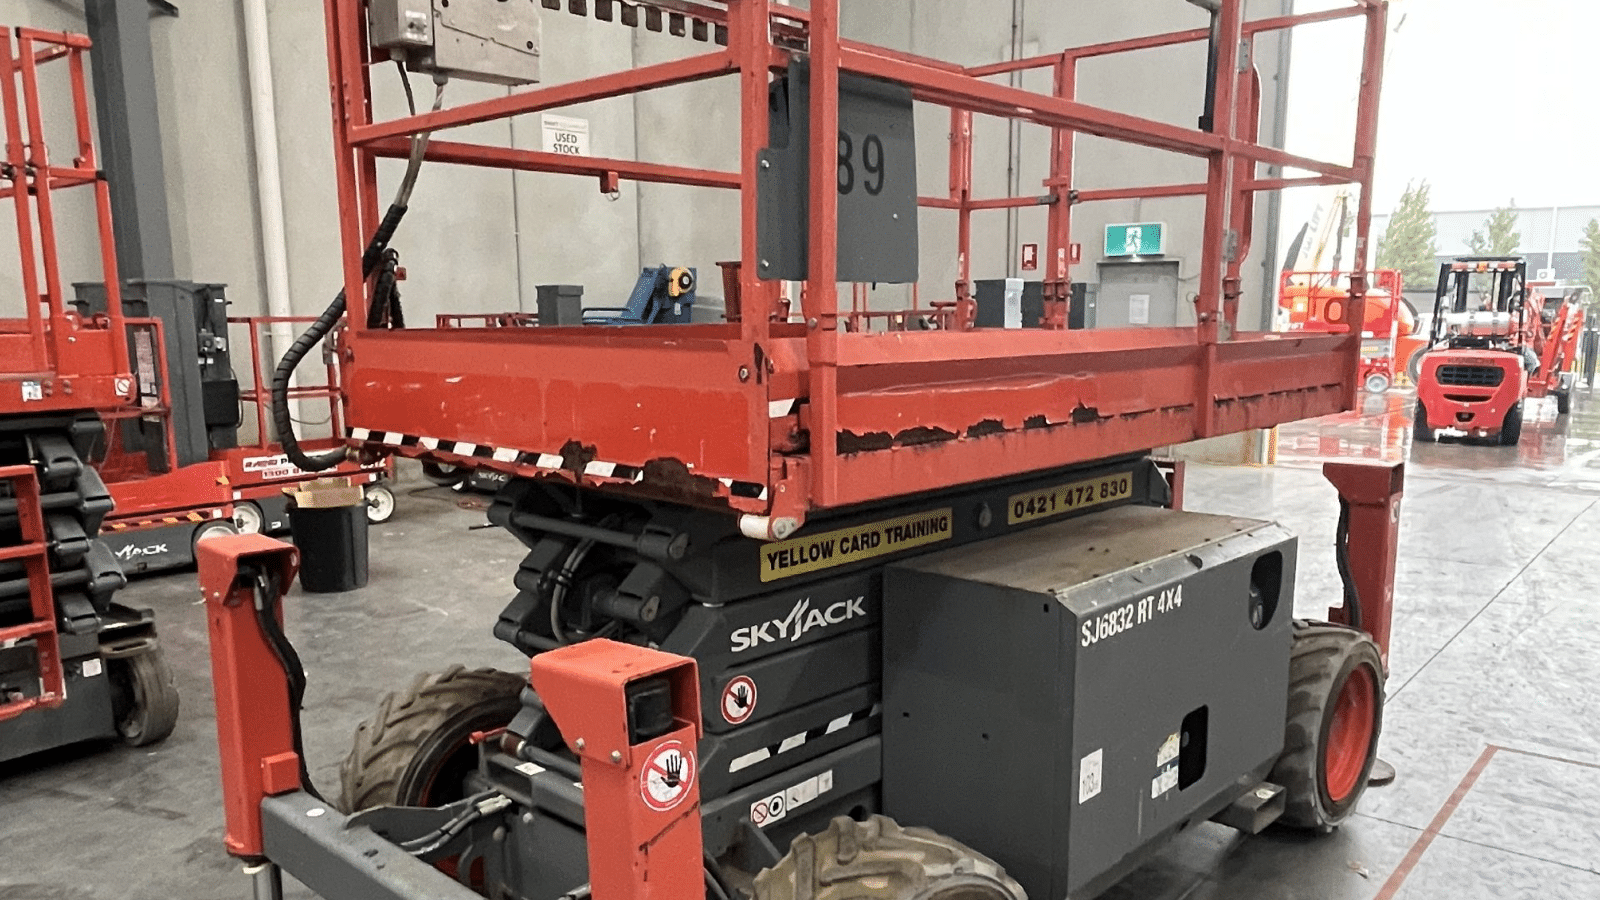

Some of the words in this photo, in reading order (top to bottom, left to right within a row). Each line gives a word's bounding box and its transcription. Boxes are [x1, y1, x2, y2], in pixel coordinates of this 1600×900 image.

[553, 143, 580, 155] STOCK
[555, 132, 578, 143] USED
[1014, 493, 1056, 518] 0421
[1064, 485, 1094, 506] 472
[1099, 478, 1127, 498] 830
[767, 539, 835, 571] YELLOW
[839, 531, 881, 554] CARD
[884, 516, 948, 544] TRAINING
[730, 596, 866, 652] SKYJACK
[1081, 603, 1134, 647] SJ6832
[1137, 595, 1155, 624] RT
[1157, 584, 1183, 613] 4X4
